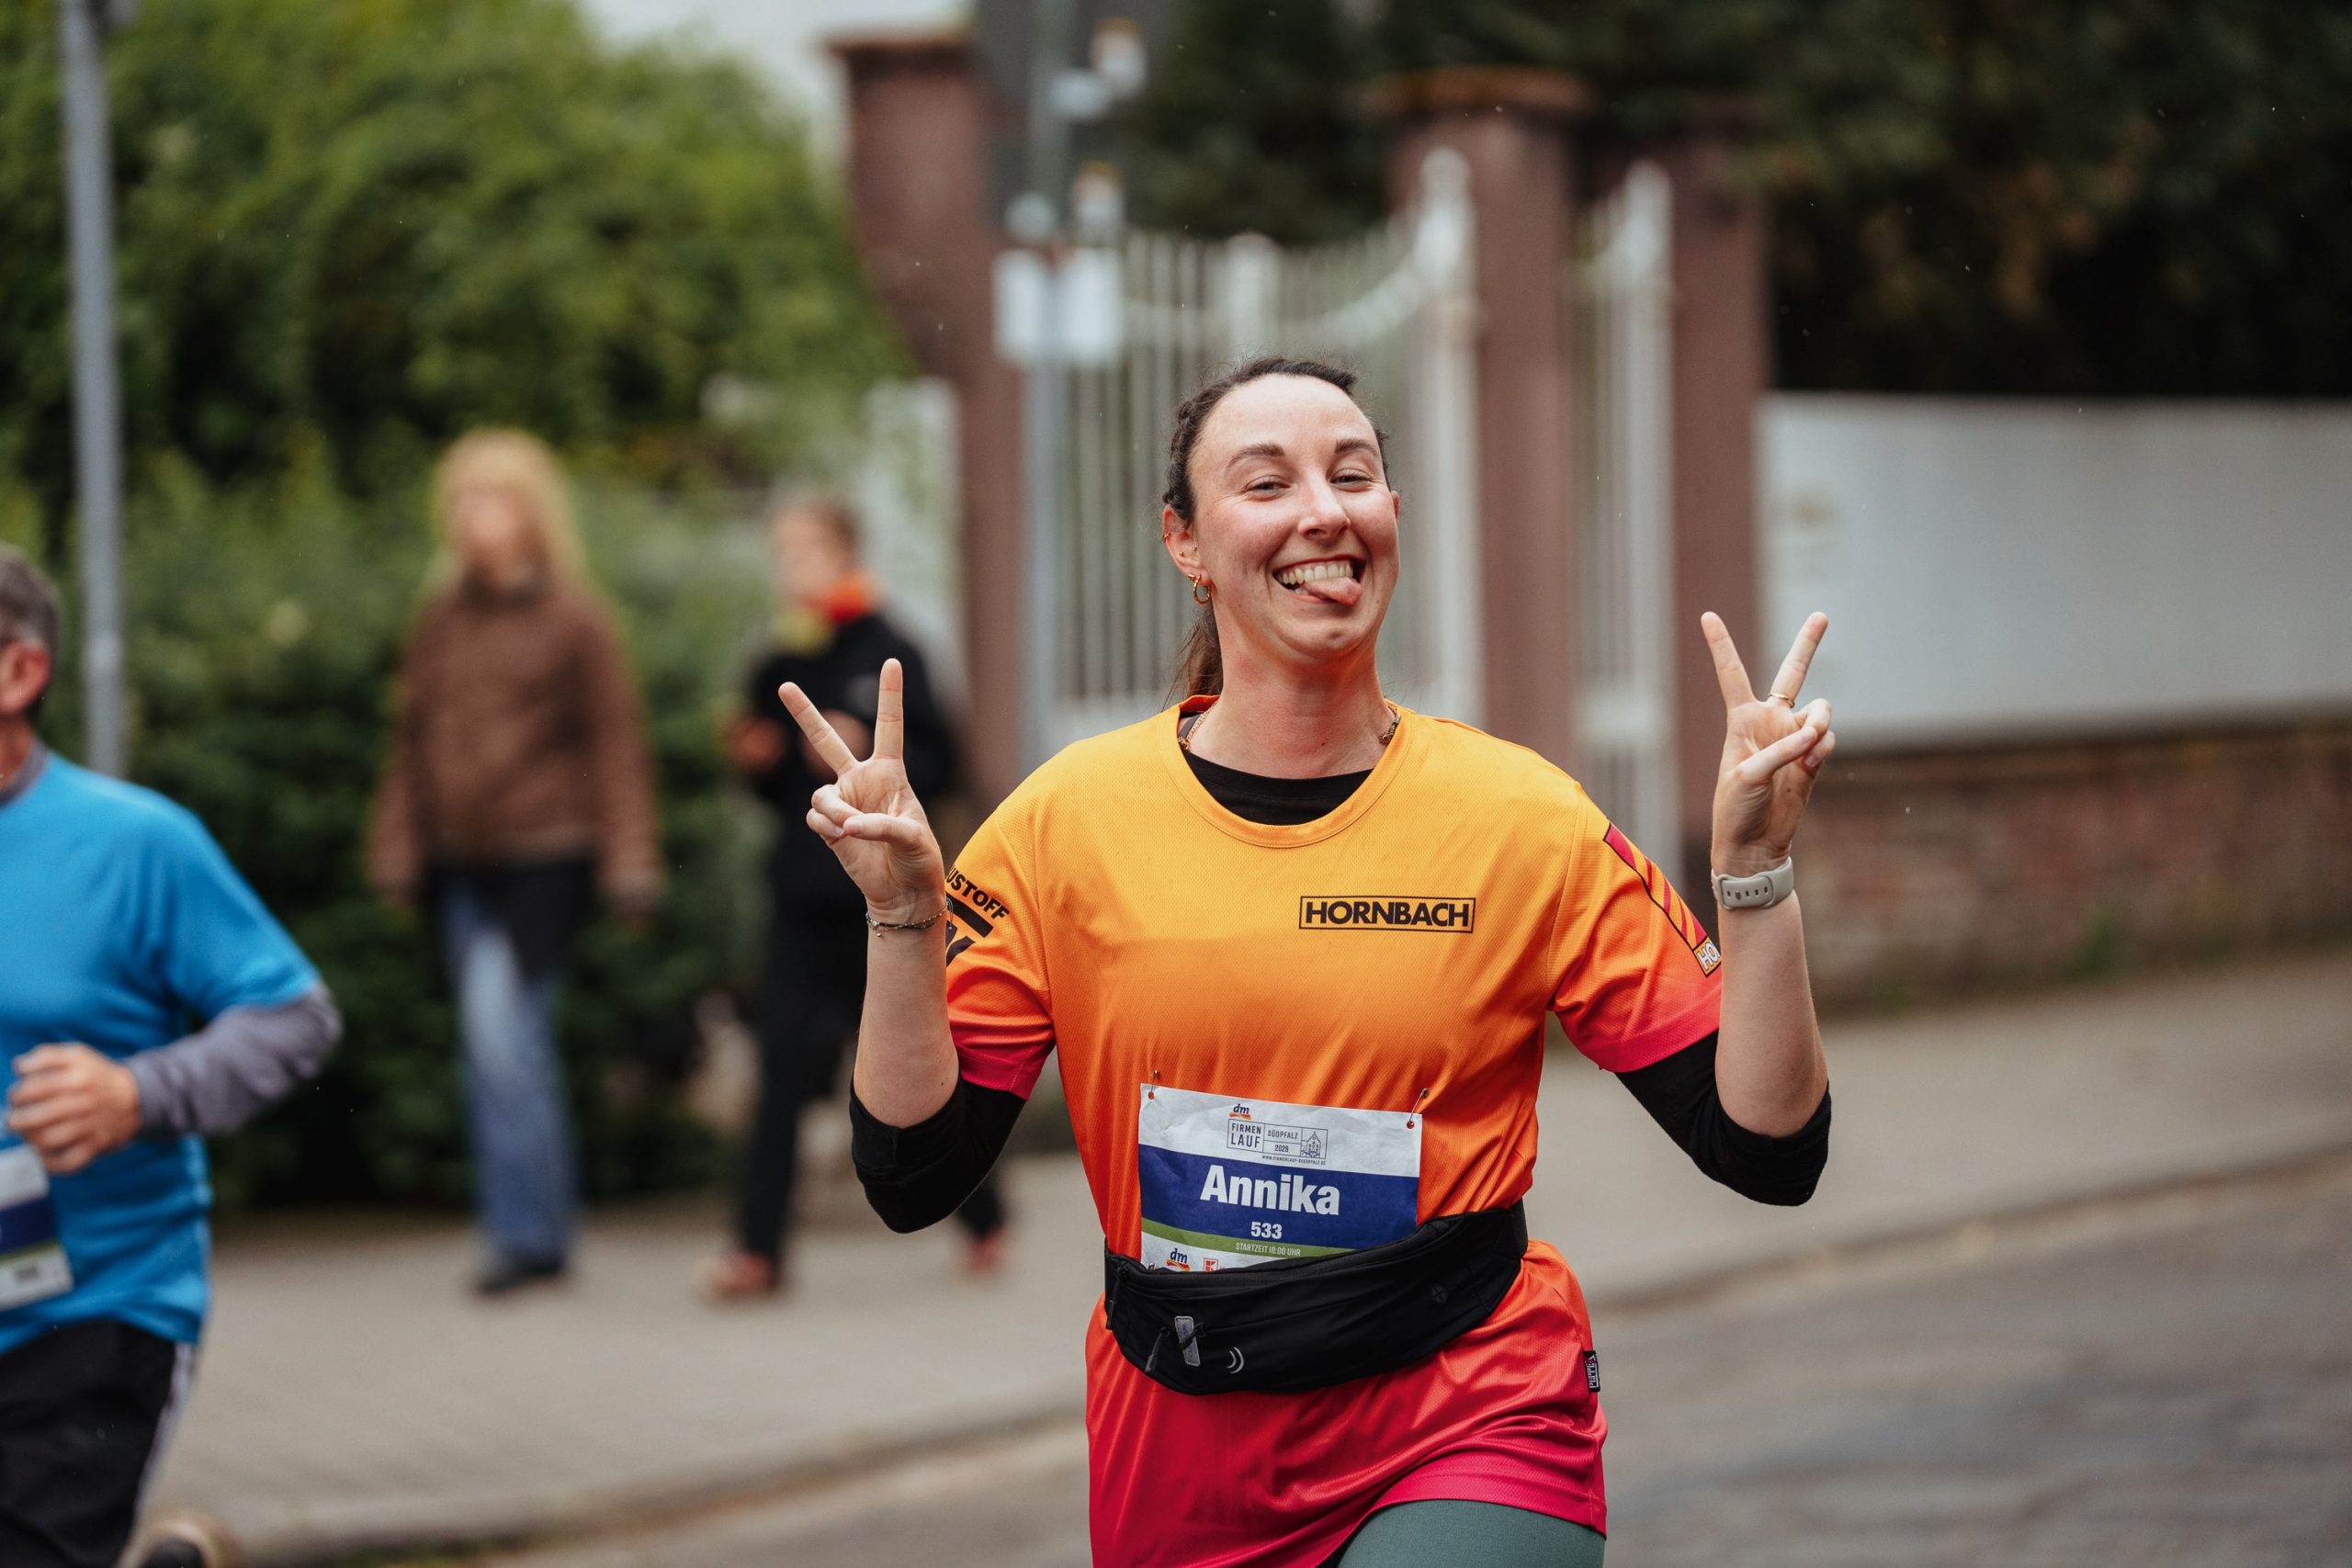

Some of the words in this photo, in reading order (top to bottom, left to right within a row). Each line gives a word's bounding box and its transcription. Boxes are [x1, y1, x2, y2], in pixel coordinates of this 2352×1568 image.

[946, 867, 1010, 919] USTOFF
[1306, 901, 1470, 927] HORNBACH
[1233, 1103, 1250, 1114] dm
[1231, 1122, 1261, 1134] FIRMEN
[1267, 1129, 1298, 1140] SÜDPFALZ
[1231, 1133, 1261, 1148] LAUF
[1200, 1164, 1340, 1216] Annika
[1250, 1221, 1283, 1240] 533
[1170, 1247, 1188, 1264] dm
[1235, 1242, 1268, 1253] STARTZEIT
[1269, 1246, 1286, 1256] 18:00
[1287, 1247, 1301, 1257] UHR
